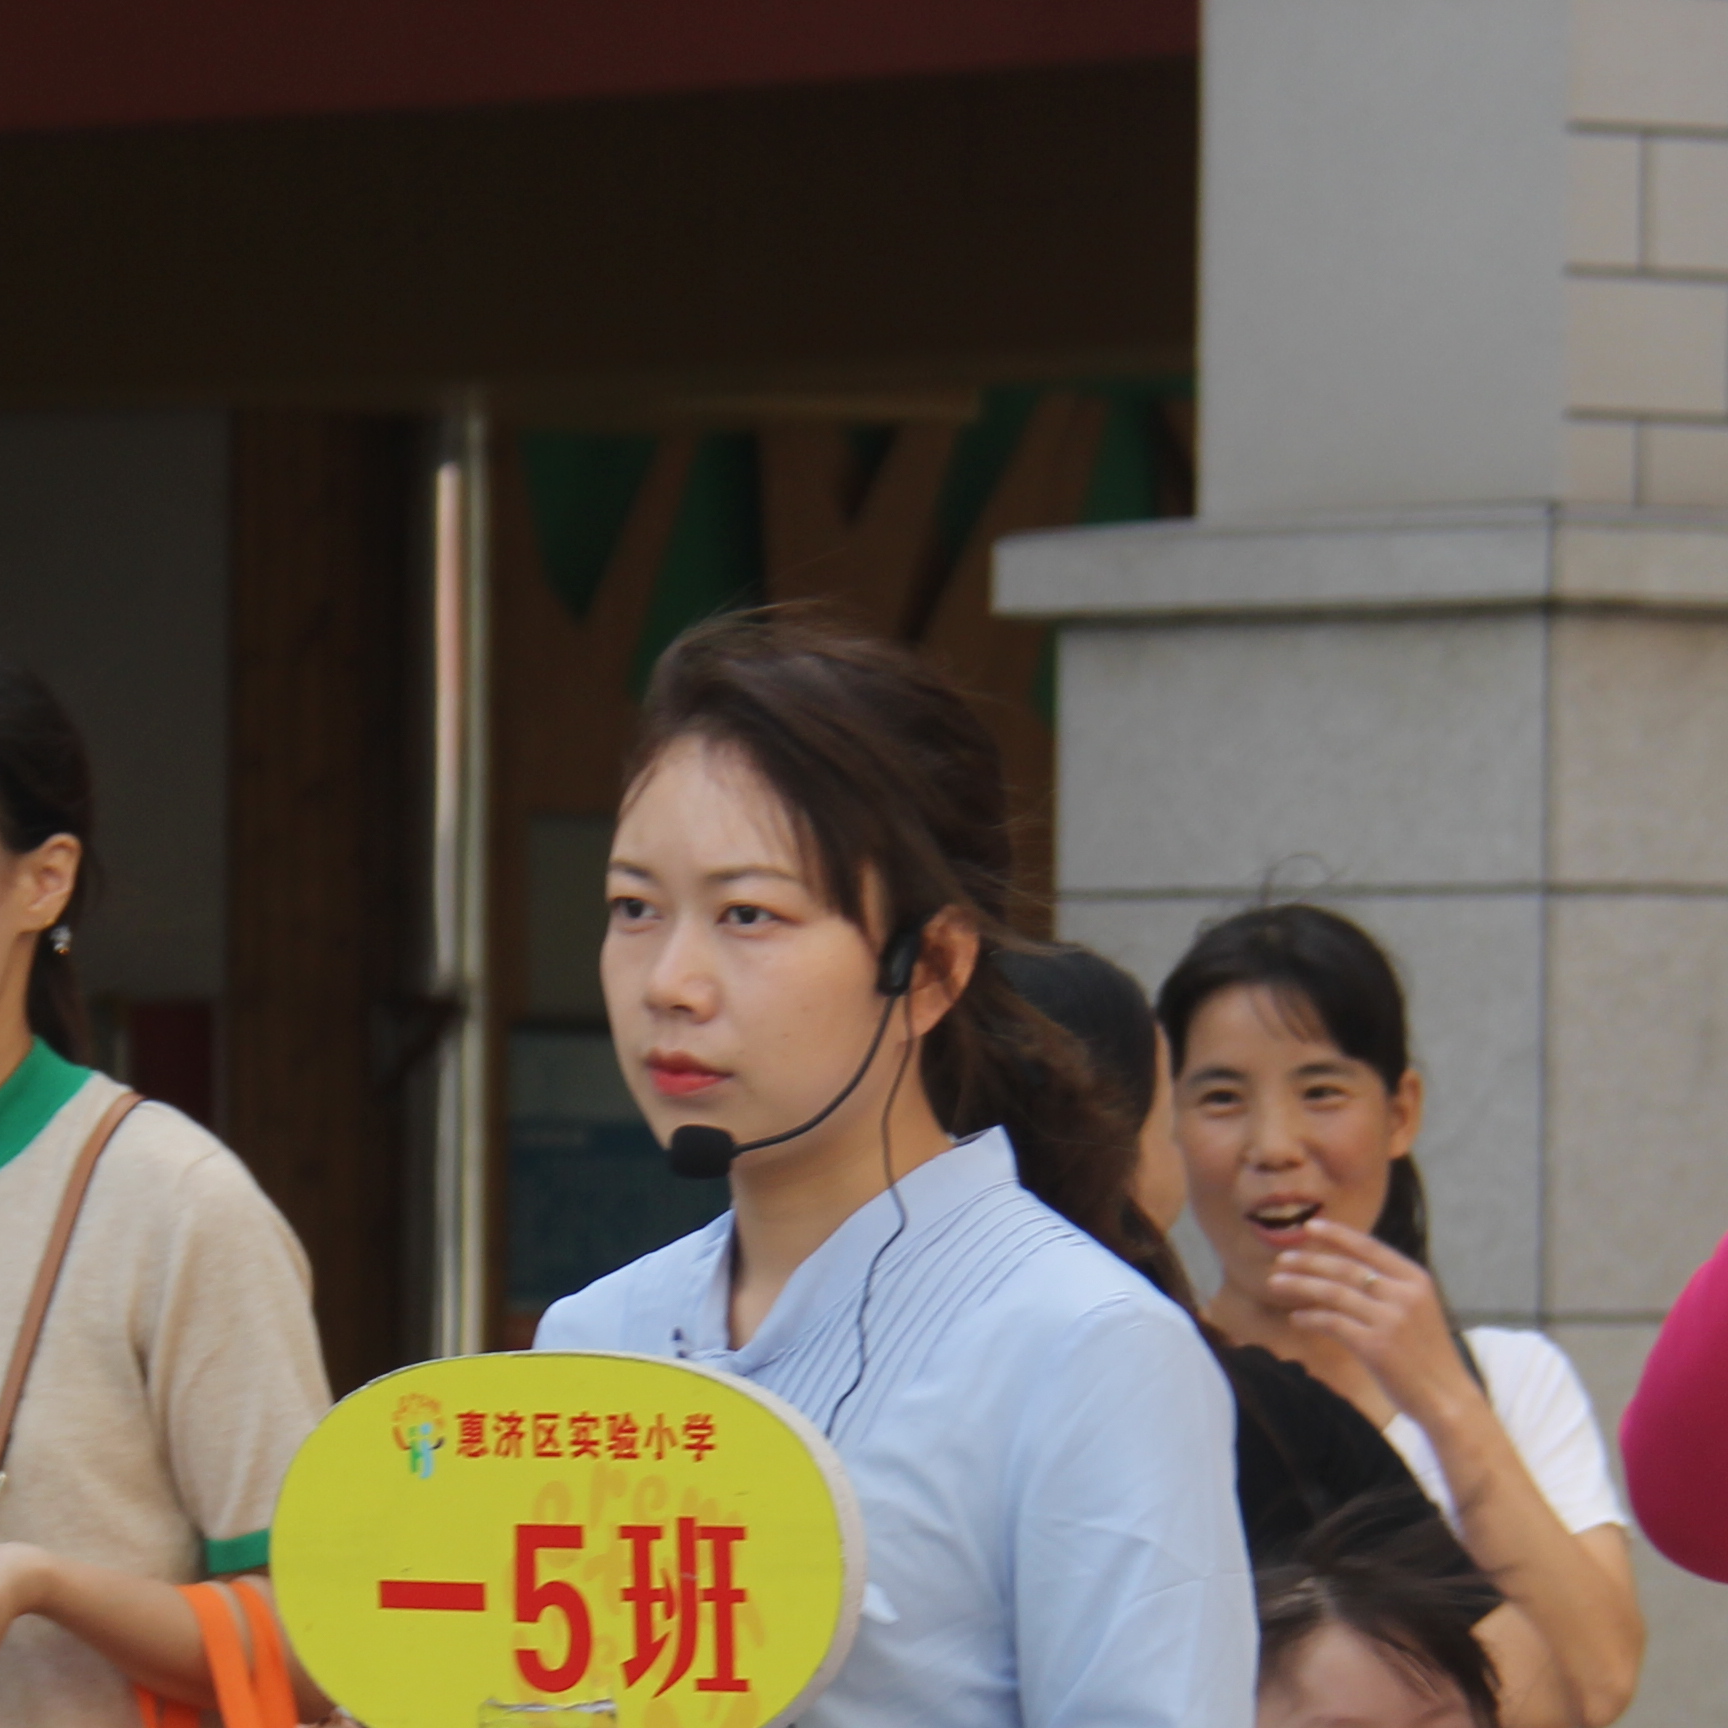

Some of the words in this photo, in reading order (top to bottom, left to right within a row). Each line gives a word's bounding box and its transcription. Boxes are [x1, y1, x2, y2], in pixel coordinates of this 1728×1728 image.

[455, 1409, 718, 1462] 惠济区实验小学
[378, 1516, 750, 1699] 一5班
